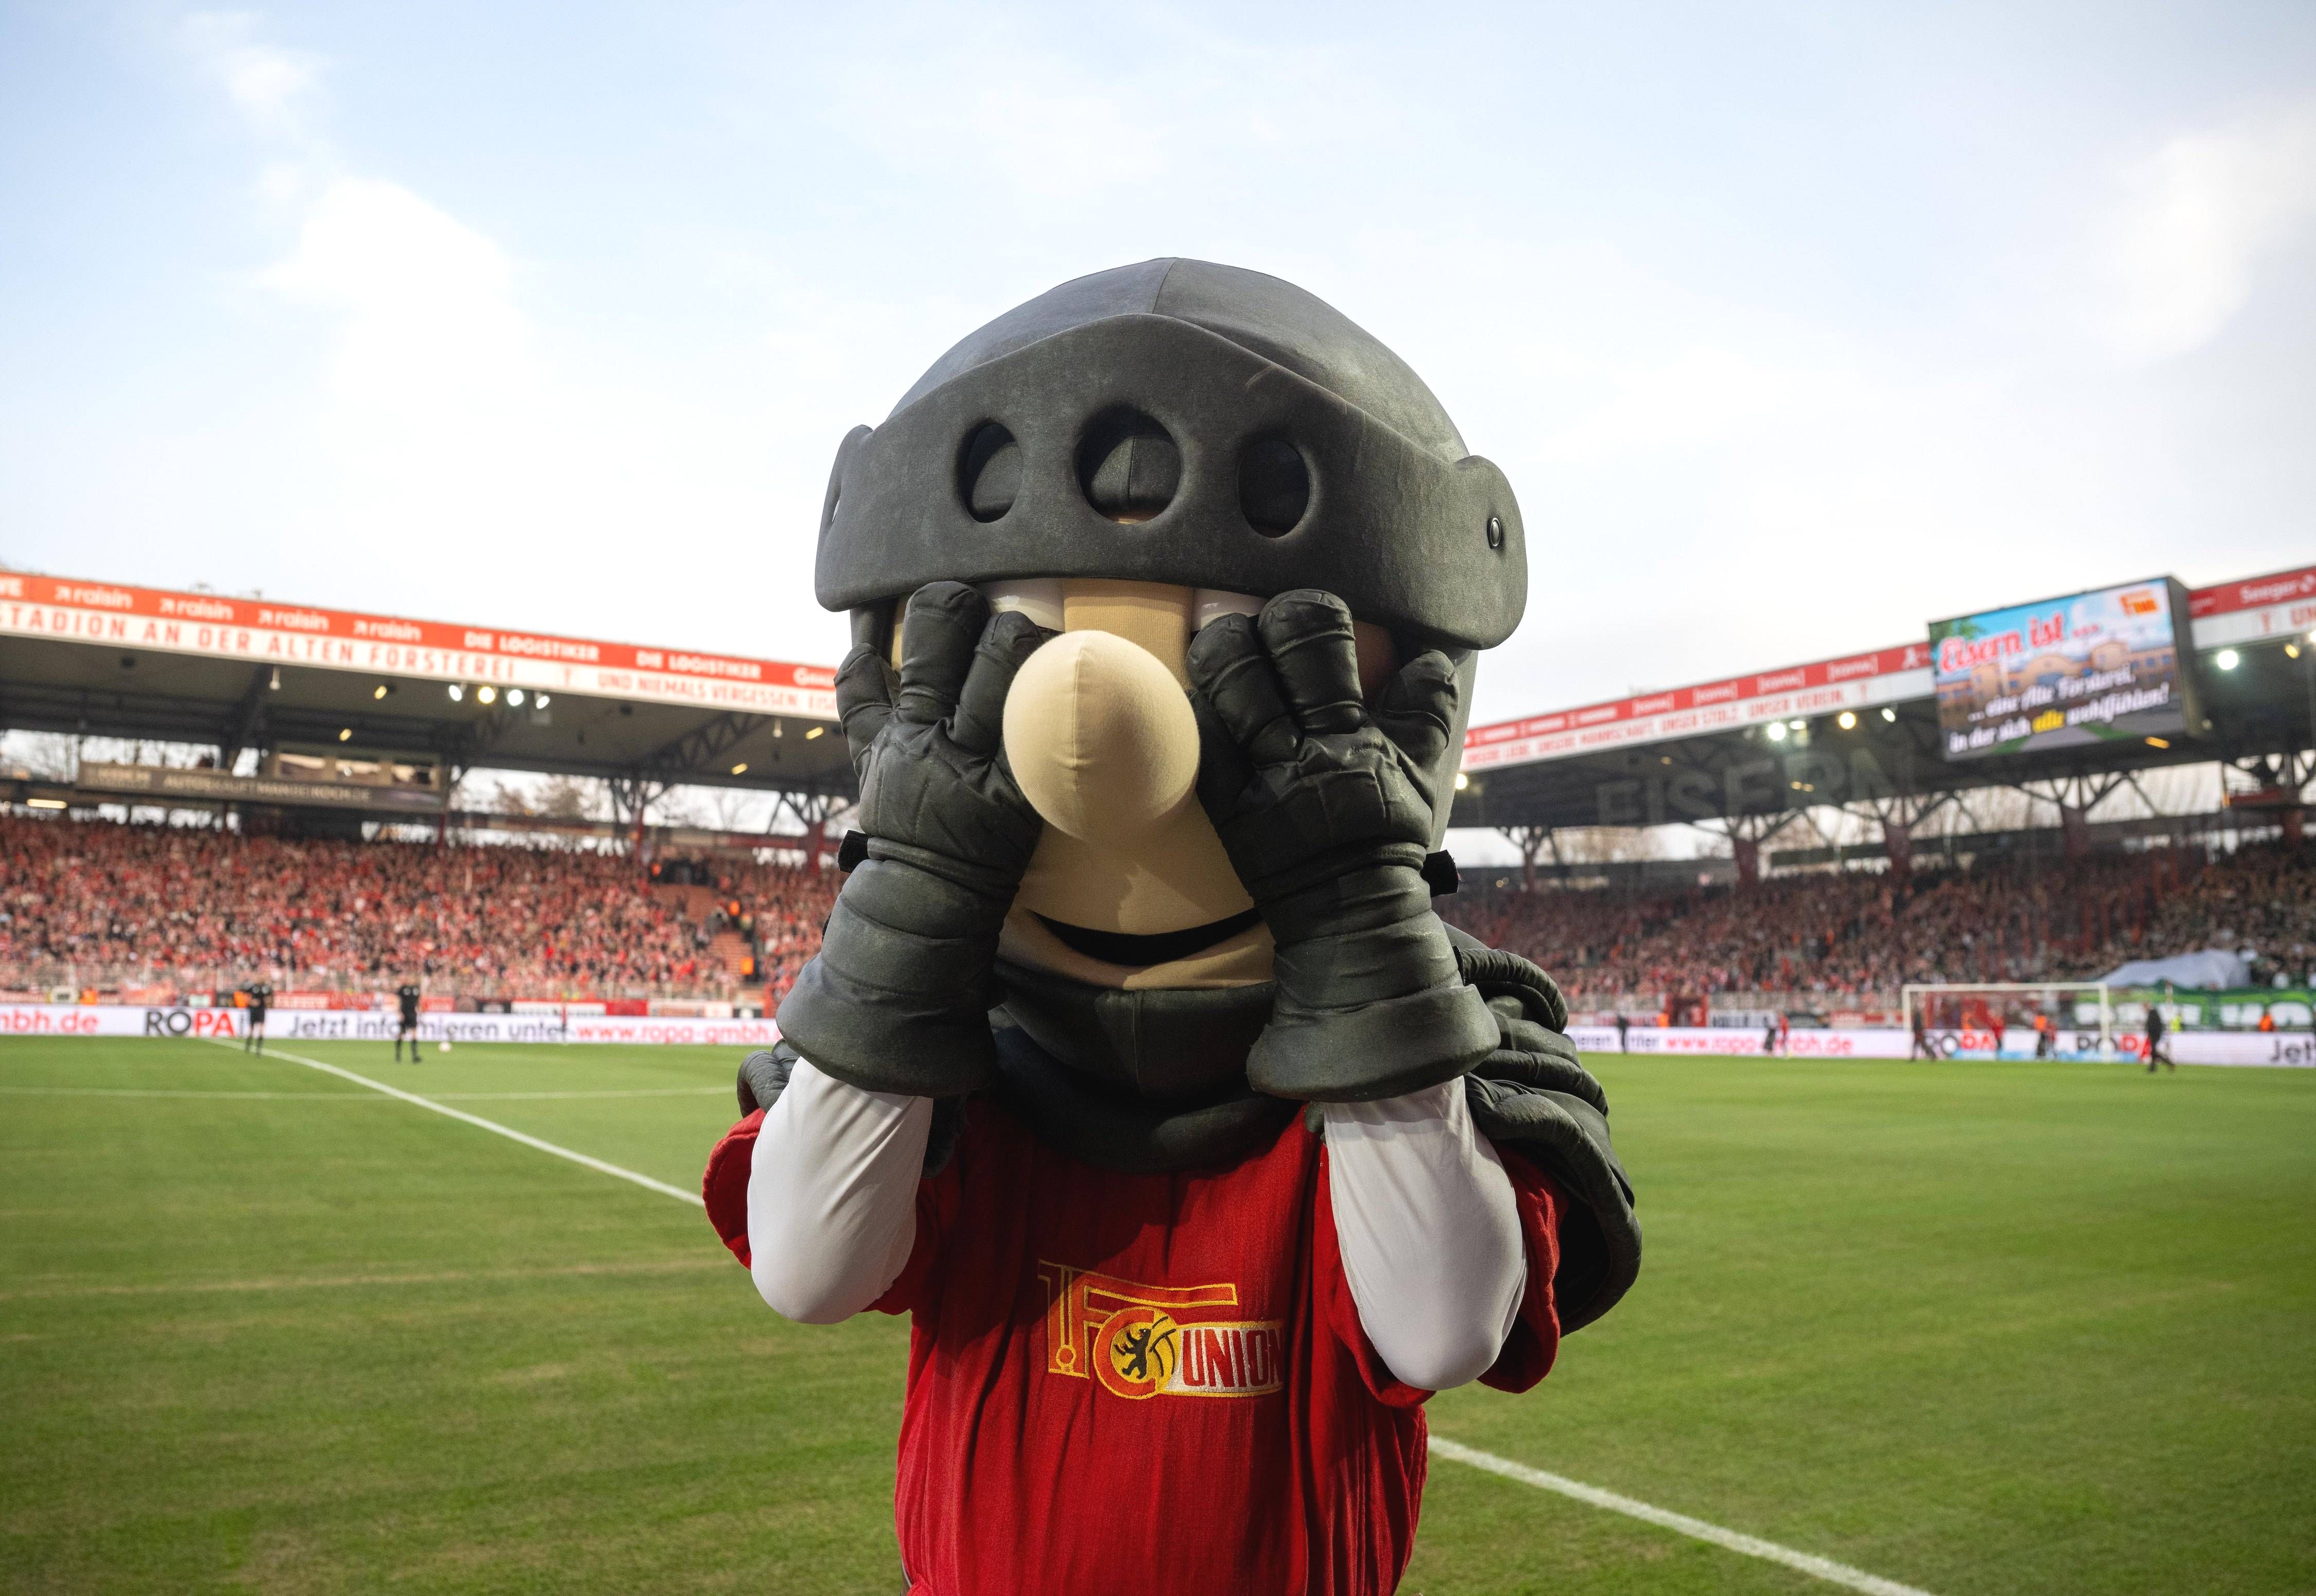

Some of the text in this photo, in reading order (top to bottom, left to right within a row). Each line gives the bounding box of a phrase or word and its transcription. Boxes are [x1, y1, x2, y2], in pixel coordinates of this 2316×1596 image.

[0, 607, 125, 637] TADION
[143, 622, 179, 643] AN
[199, 628, 250, 651] DER
[268, 636, 352, 663] ALTEN
[464, 631, 599, 662] DIE LOGISTIKER
[1941, 631, 2023, 671] Eisern
[2029, 613, 2064, 648] ist
[636, 650, 761, 680] DIE LOGISTIKER
[1986, 695, 2021, 718] eine
[2021, 684, 2056, 711] Alte
[1950, 732, 1968, 753] in
[1969, 725, 1995, 749] der
[1997, 717, 2031, 743] sich
[2032, 708, 2065, 734] alle
[145, 1010, 235, 1037] ROPA
[289, 1015, 347, 1038] Jetzt
[356, 1015, 499, 1040] infomieren
[1182, 1328, 1284, 1388] UNION
